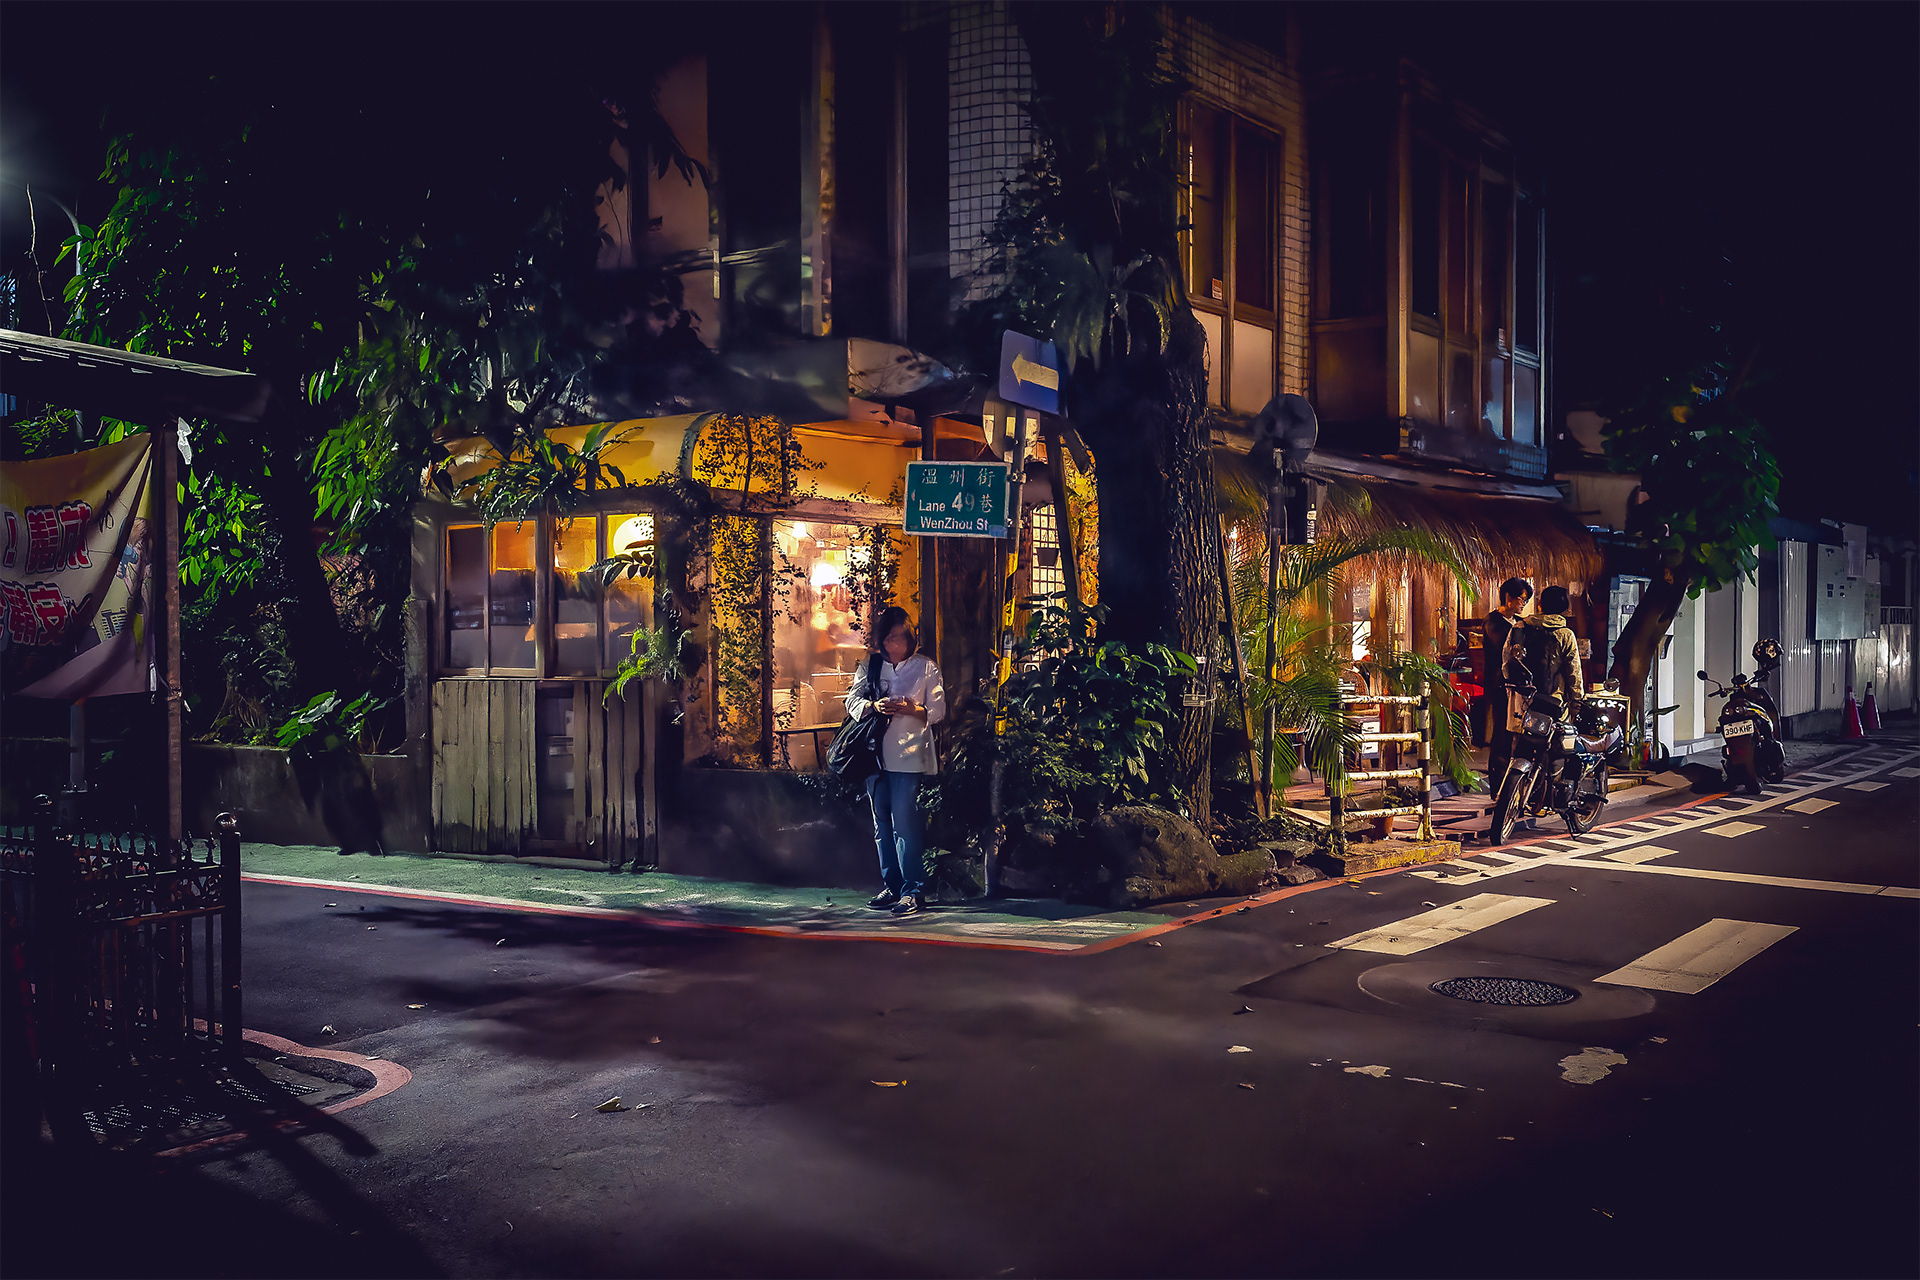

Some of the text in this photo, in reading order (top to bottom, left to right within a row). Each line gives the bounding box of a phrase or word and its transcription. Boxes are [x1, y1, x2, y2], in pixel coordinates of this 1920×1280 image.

[922, 468, 995, 488] 溫州街
[919, 499, 946, 512] Lane
[980, 493, 993, 513] 巷
[920, 516, 989, 531] WenZhou St
